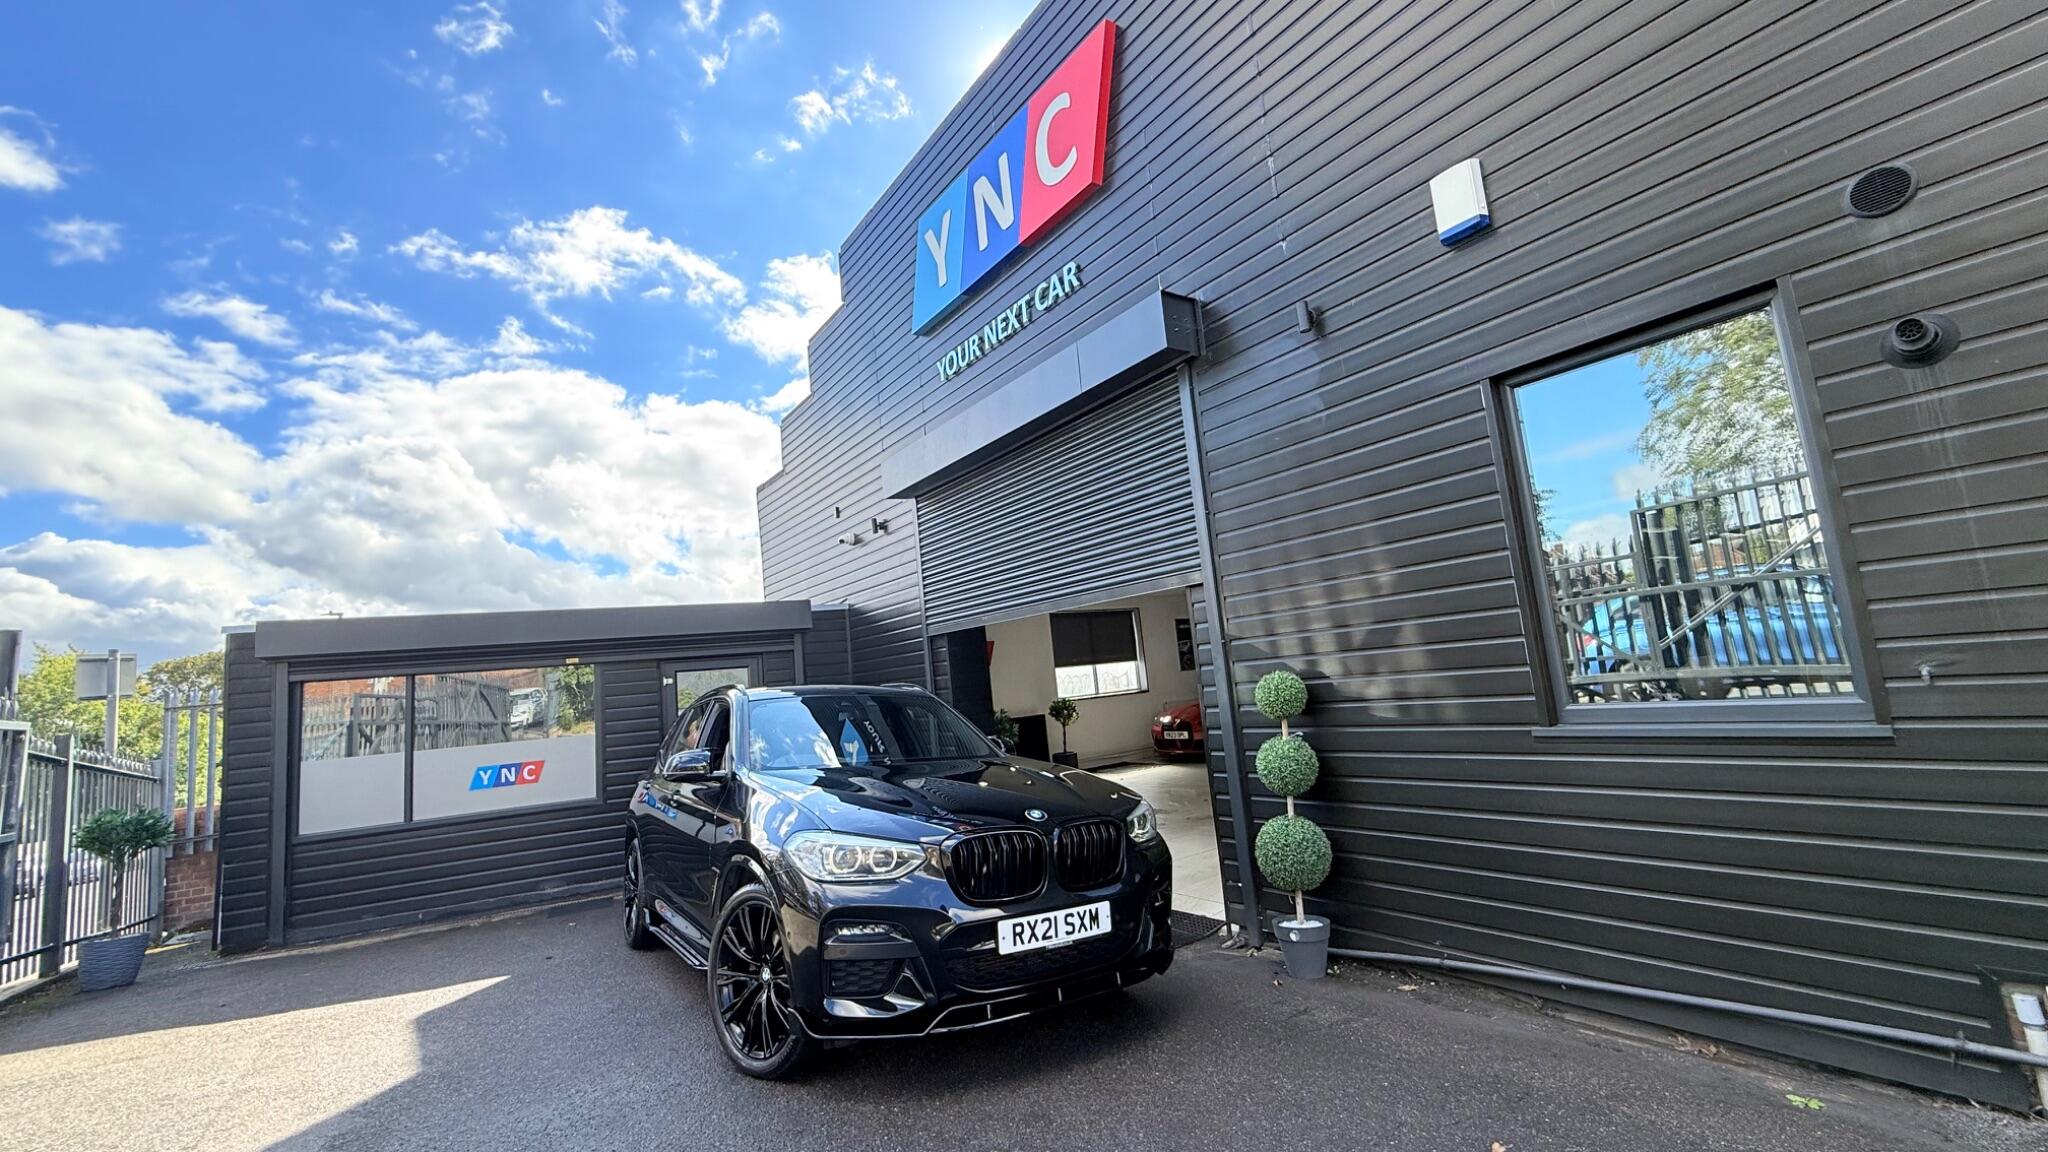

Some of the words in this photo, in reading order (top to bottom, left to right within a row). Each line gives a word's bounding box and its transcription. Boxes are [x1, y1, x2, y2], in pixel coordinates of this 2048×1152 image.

[924, 91, 1078, 288] YNC
[936, 333, 982, 382] YOUR
[982, 293, 1031, 350] NEXT
[1034, 261, 1081, 311] CAR
[478, 765, 537, 785] YNC
[1012, 915, 1059, 947] RX21
[1064, 907, 1100, 936] SXM
